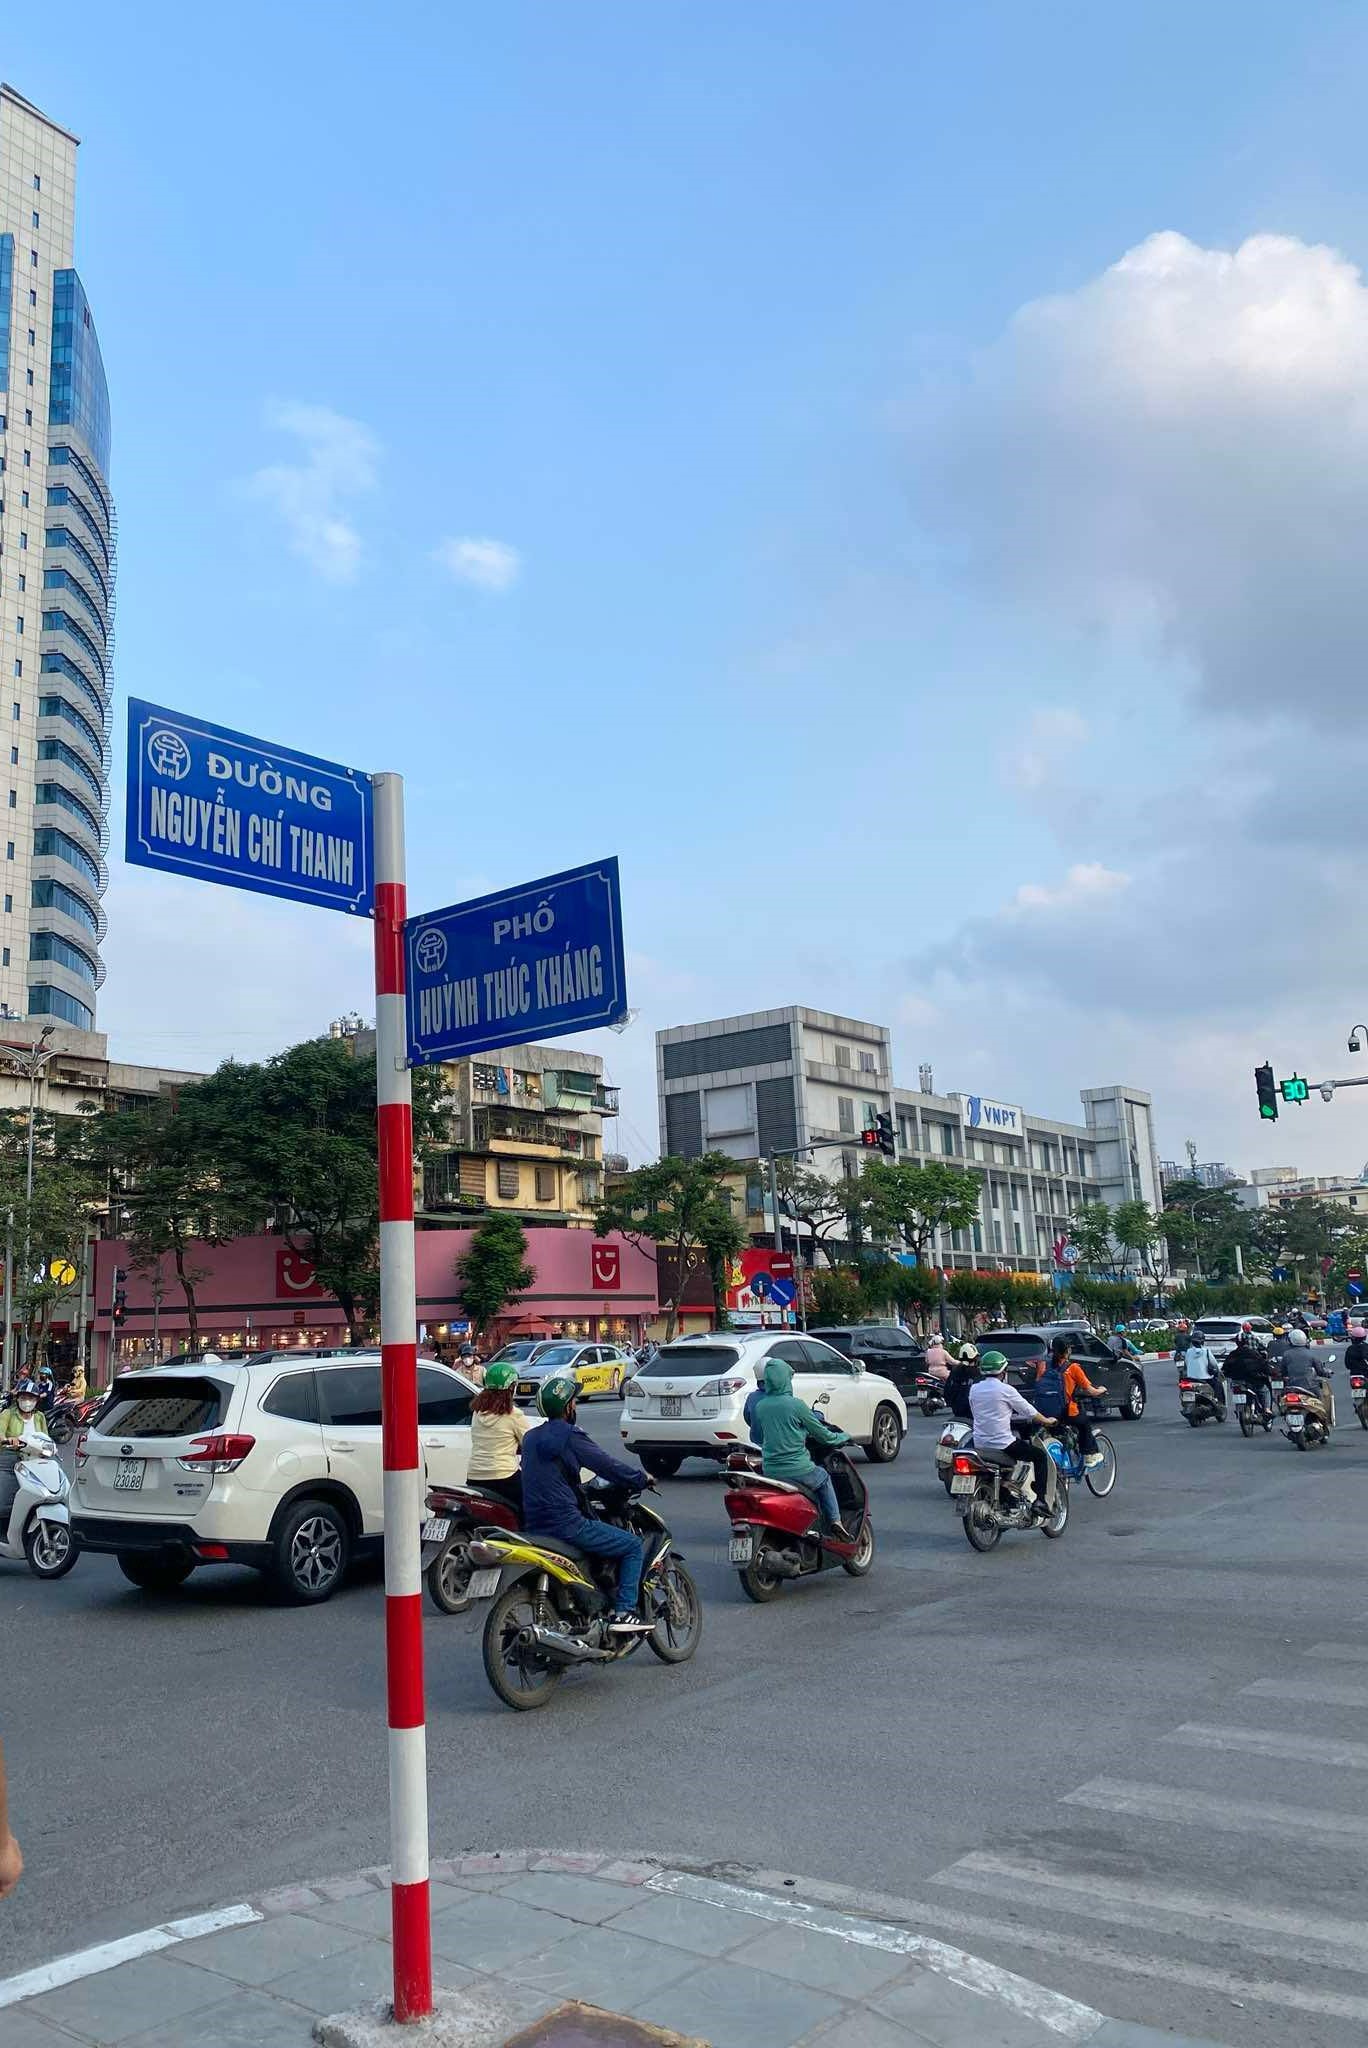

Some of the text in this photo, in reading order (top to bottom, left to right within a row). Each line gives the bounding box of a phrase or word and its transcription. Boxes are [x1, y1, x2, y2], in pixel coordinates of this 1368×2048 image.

[207, 752, 332, 811] ĐƯỜNG
[151, 787, 354, 886] NGUYỄN CHÍ THANH
[493, 893, 556, 945] PHỐ
[420, 941, 604, 1036] HUỲNH THÚC KHÁNG
[984, 1106, 1016, 1128] VNPT
[1284, 1080, 1306, 1100] 30
